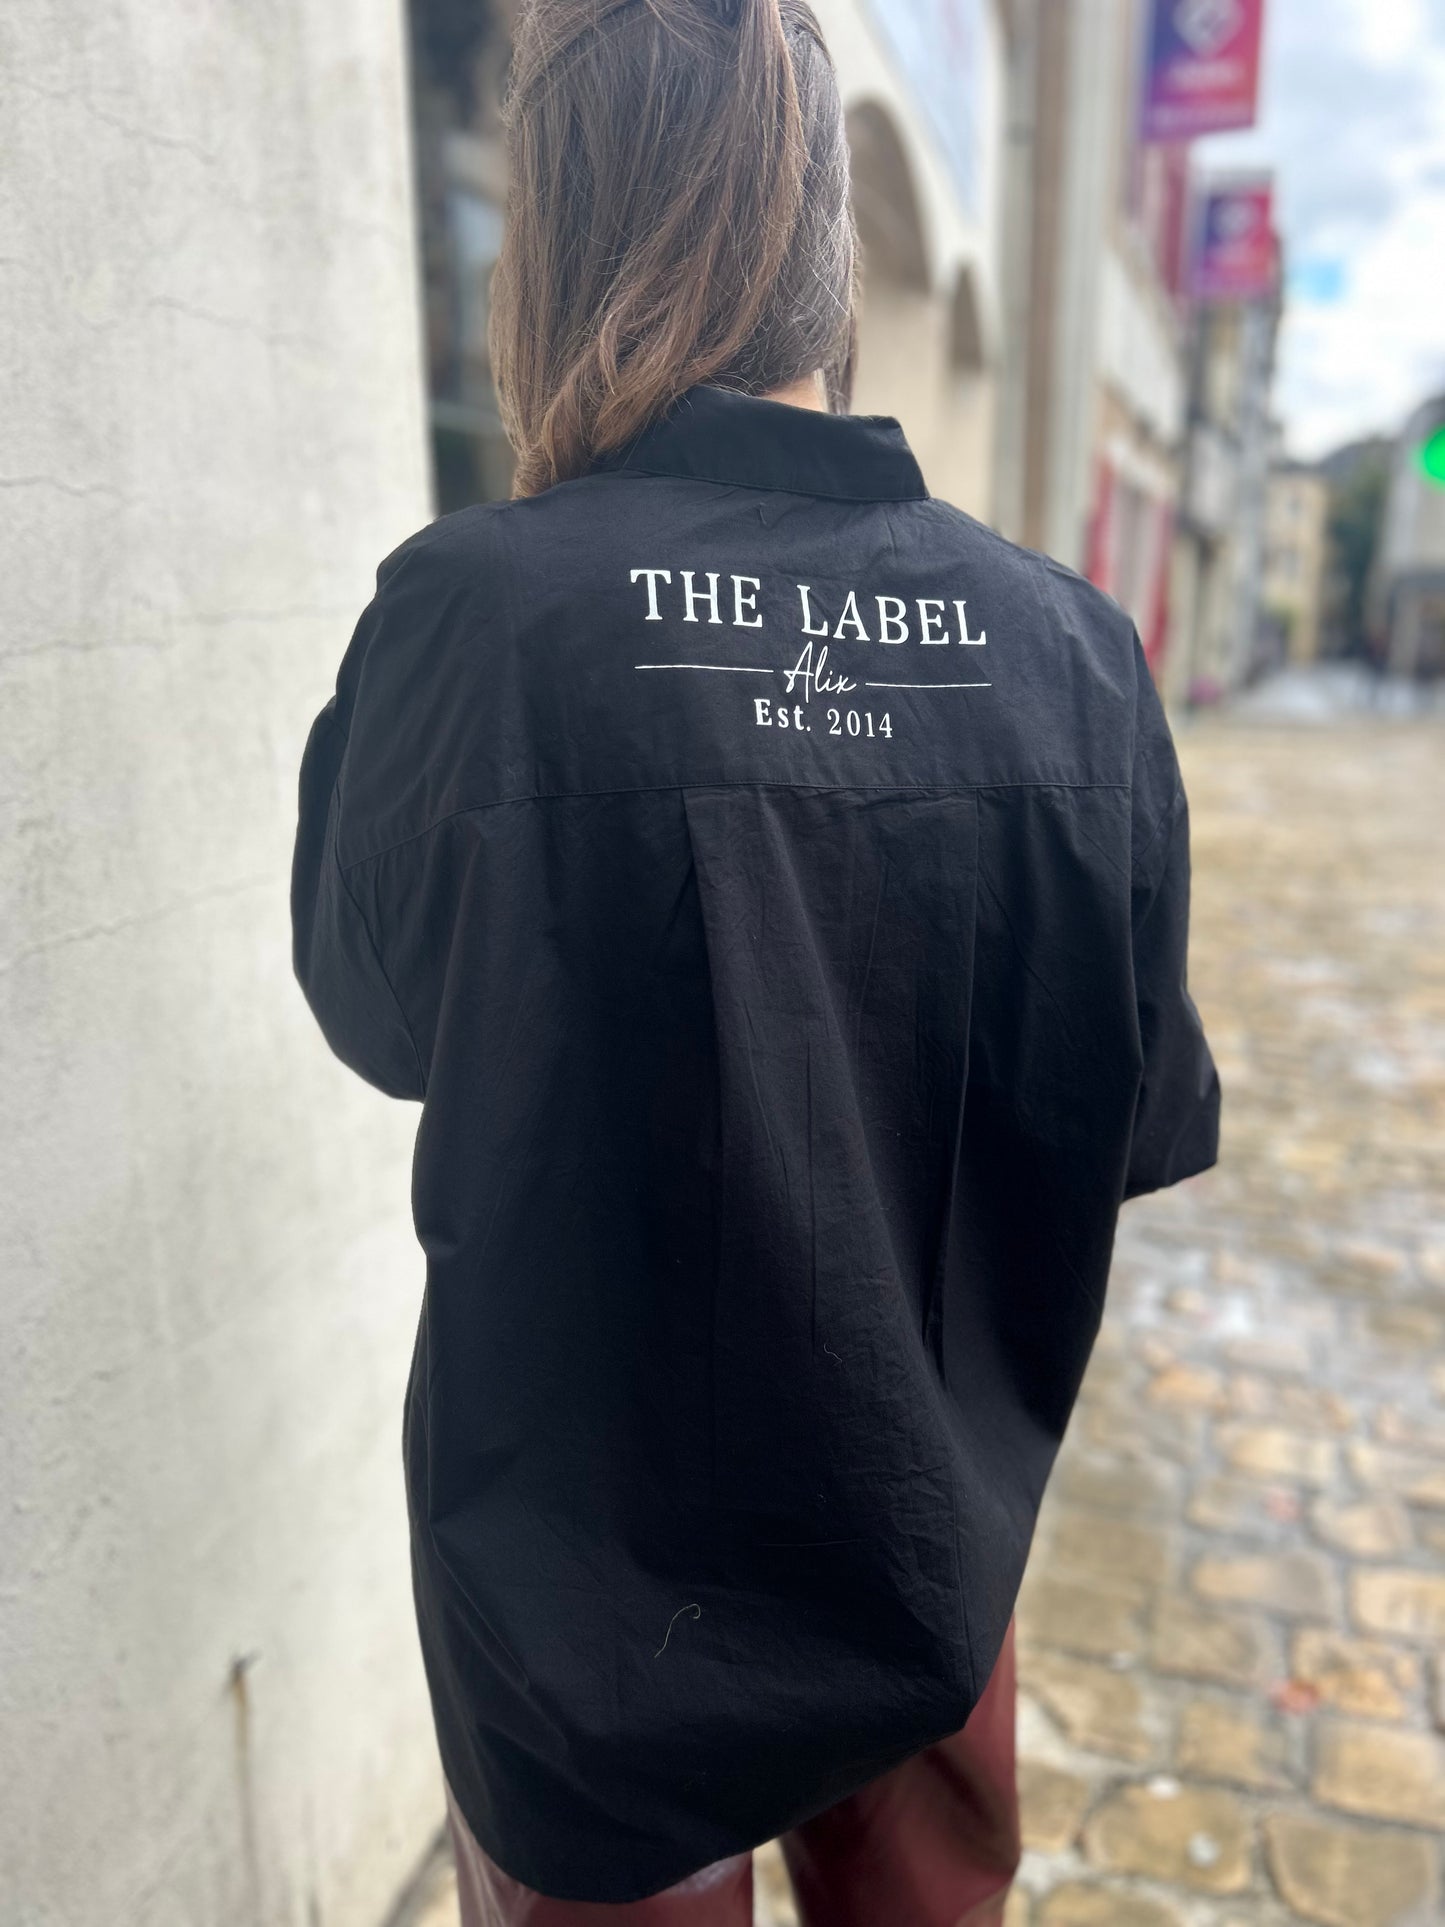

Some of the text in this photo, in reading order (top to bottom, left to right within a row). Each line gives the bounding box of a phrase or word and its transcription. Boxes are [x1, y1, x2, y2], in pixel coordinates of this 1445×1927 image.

[629, 568, 988, 646] THE LABEL
[783, 640, 858, 704] Alix
[753, 698, 893, 739] Est. 2014
